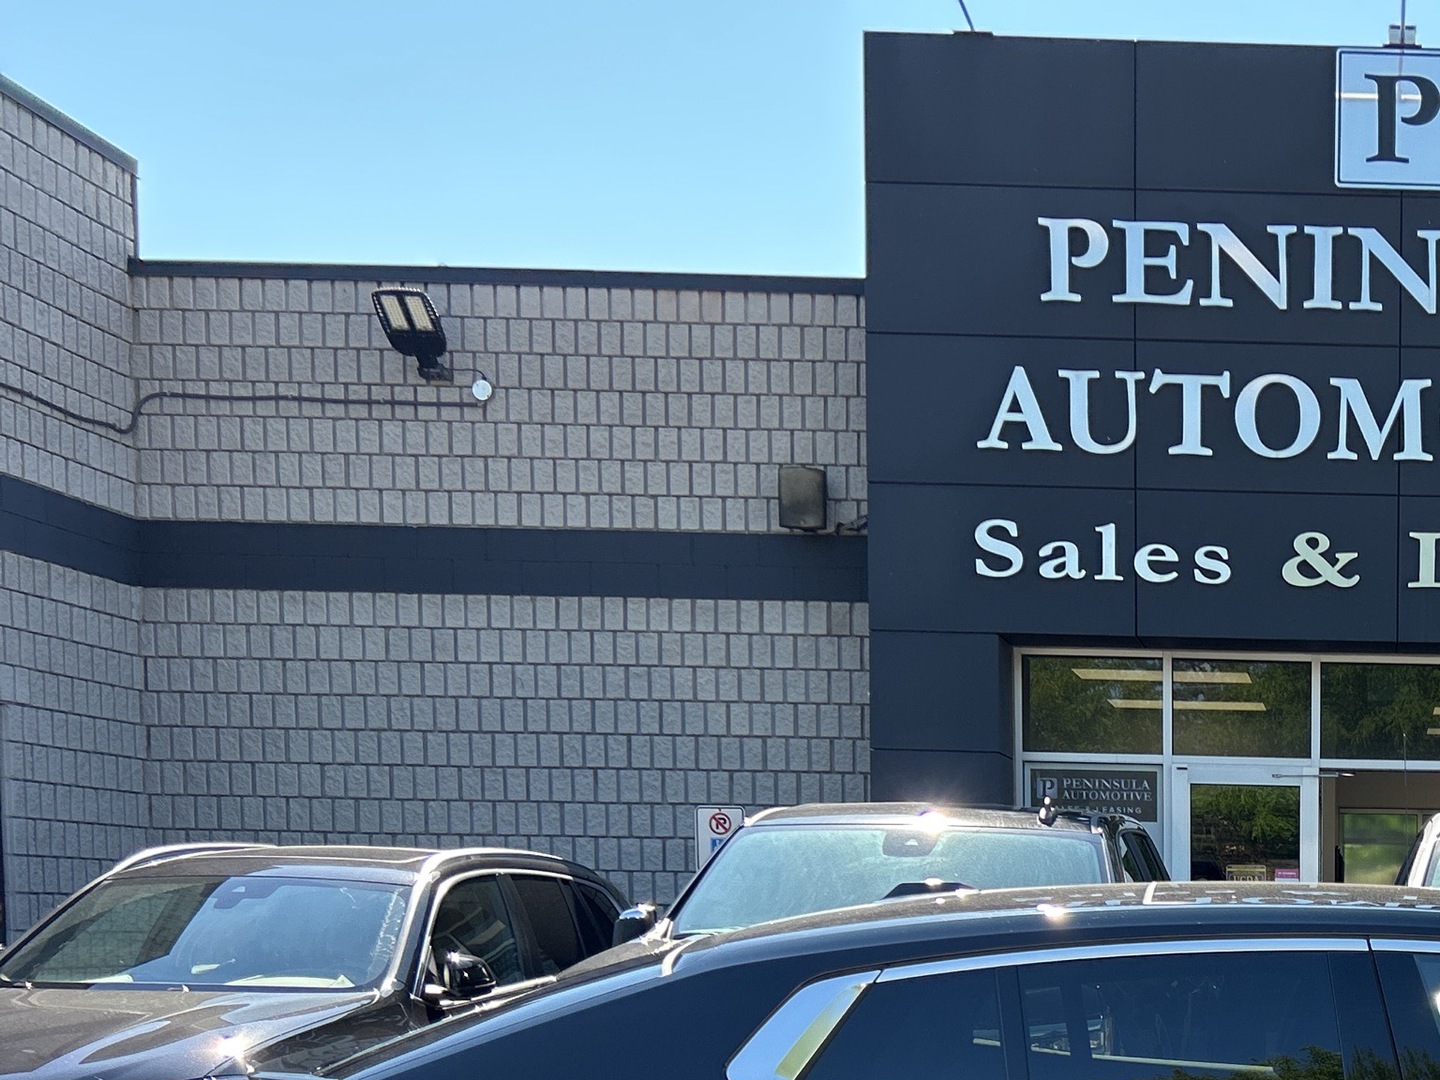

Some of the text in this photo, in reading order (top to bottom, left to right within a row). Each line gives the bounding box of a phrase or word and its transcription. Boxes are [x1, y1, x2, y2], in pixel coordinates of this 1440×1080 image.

[1363, 73, 1440, 163] P
[974, 518, 1231, 587] Sales
[1281, 531, 1360, 590] &
[1062, 790, 1152, 801] AUTOMOTIVE
[1063, 778, 1150, 790] PENINSULA
